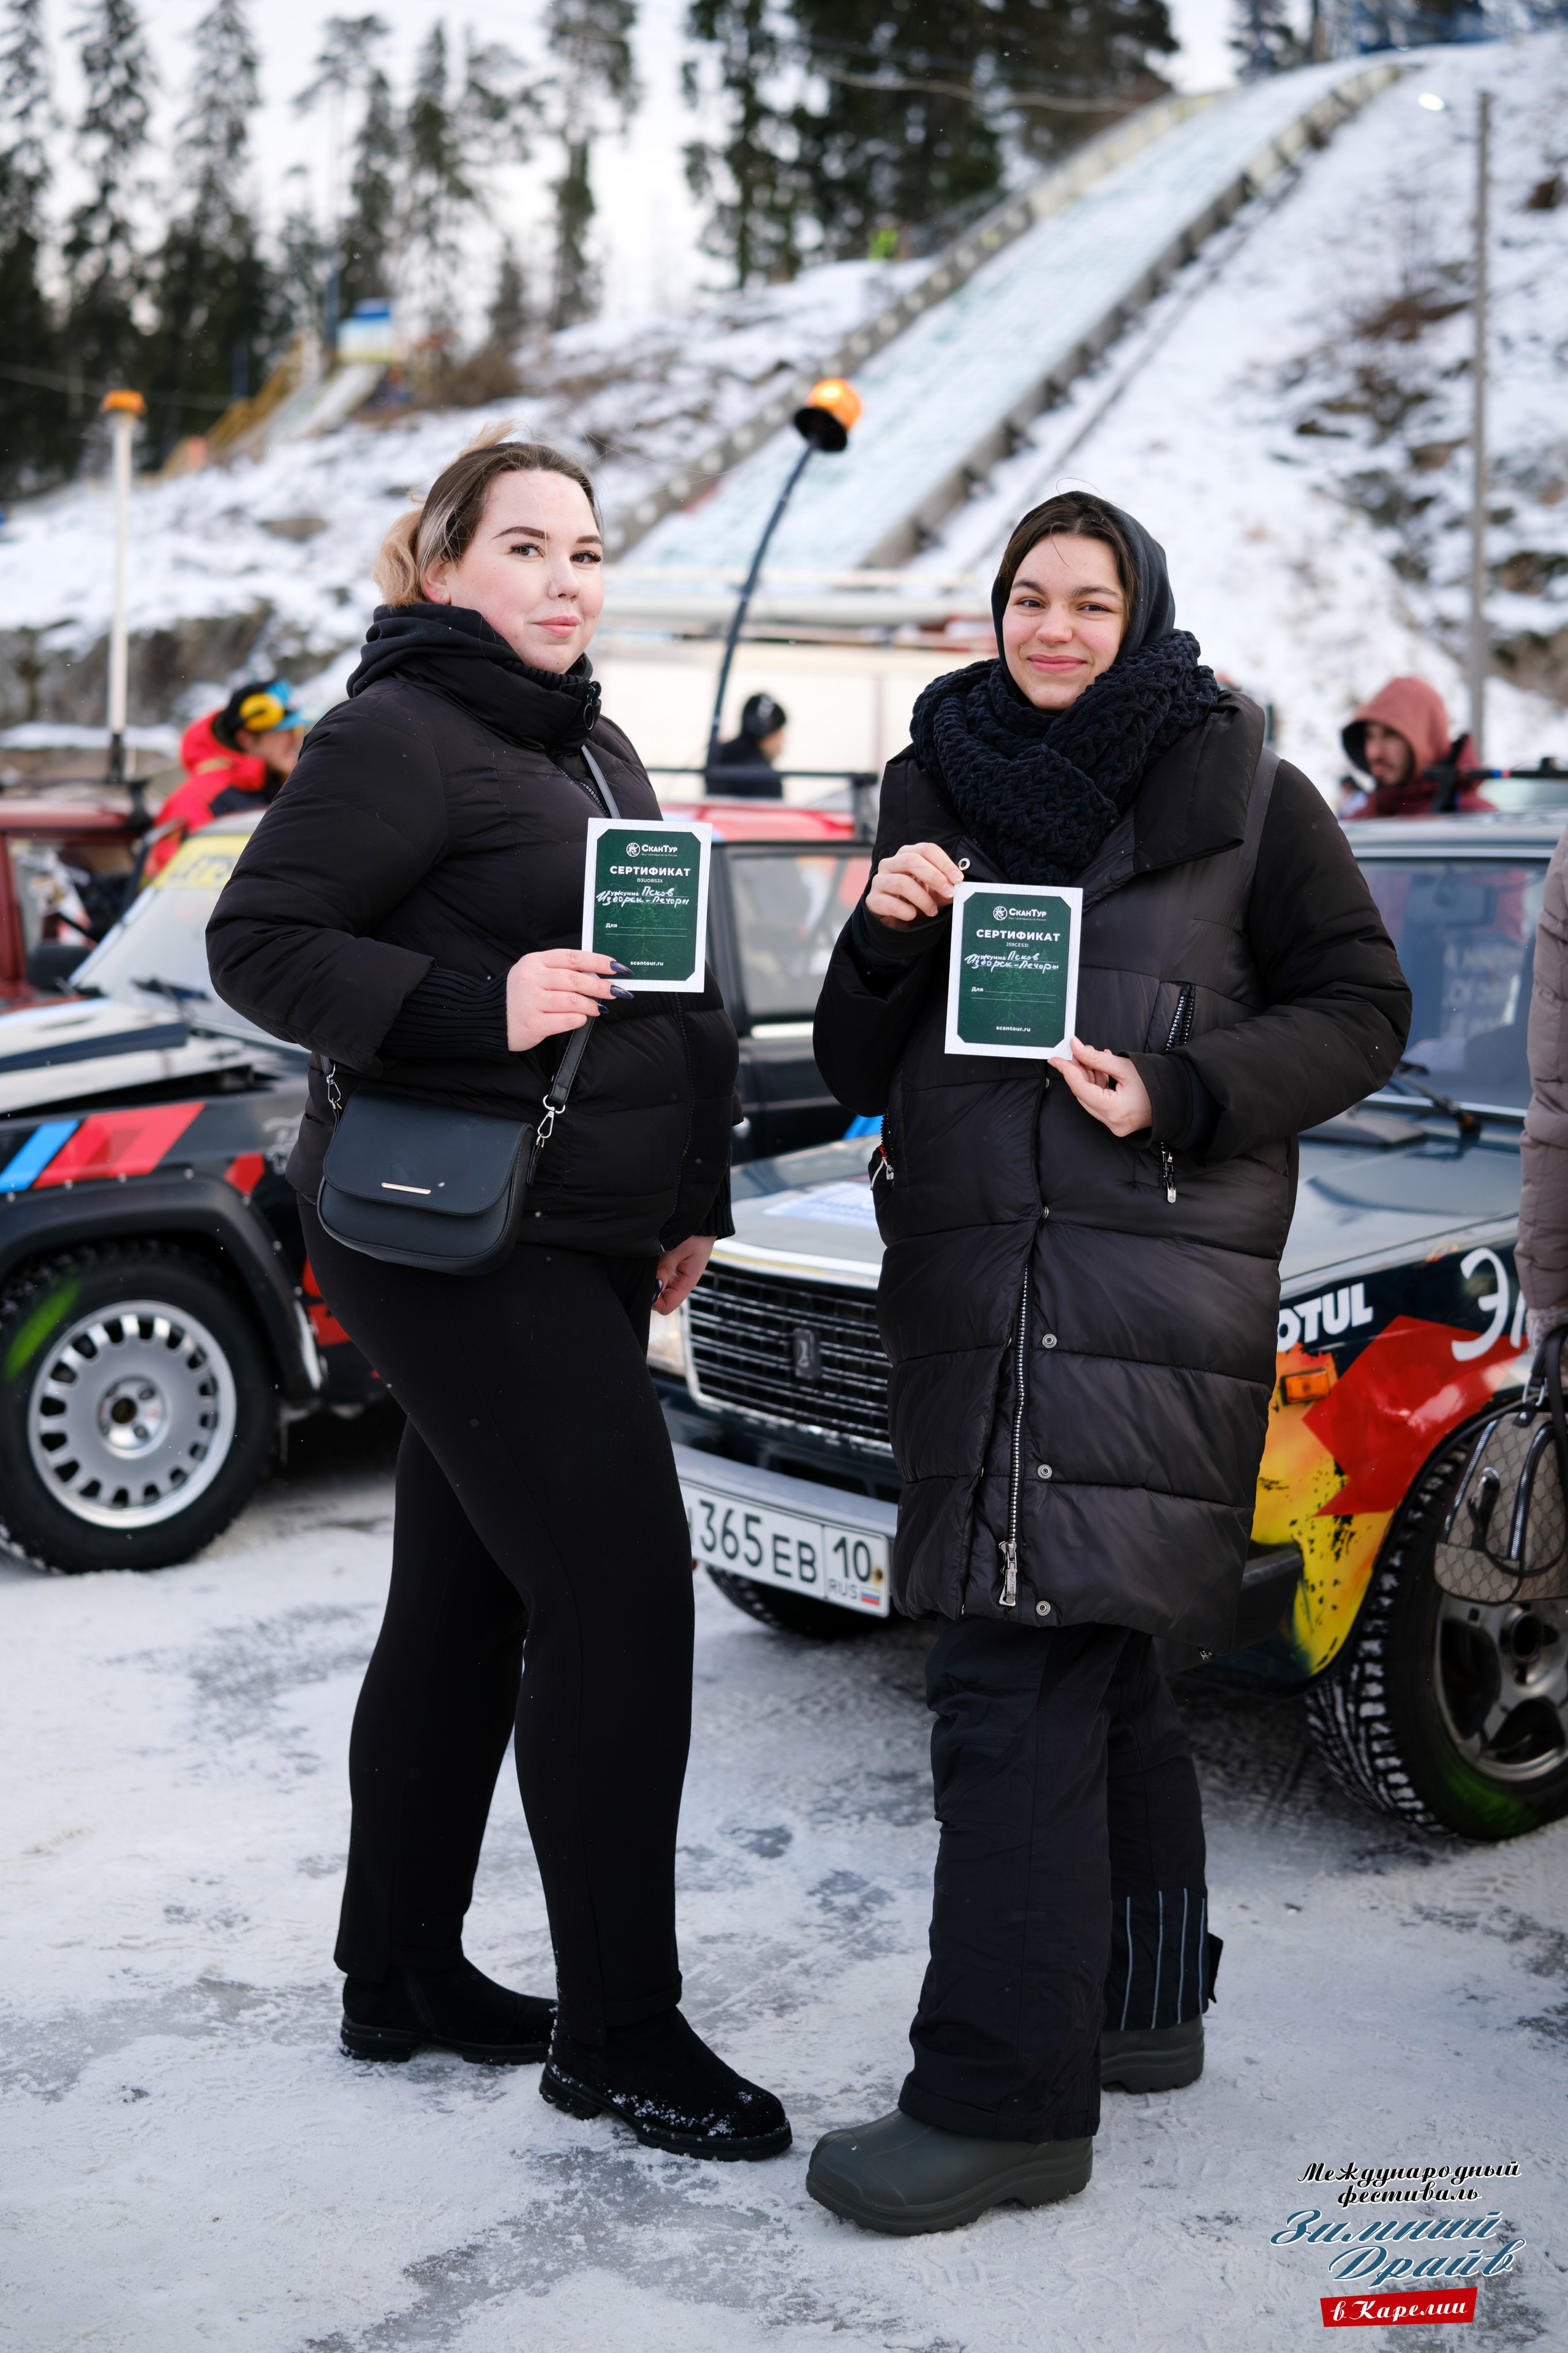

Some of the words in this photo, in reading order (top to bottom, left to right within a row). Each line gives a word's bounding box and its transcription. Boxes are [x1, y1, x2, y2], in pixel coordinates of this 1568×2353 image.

[609, 866, 691, 877] СЕРТИФИКАТ
[976, 929, 1060, 942] СЕРТИФИКАТ
[1278, 1282, 1373, 1352] OTUL
[832, 1536, 872, 1582] 10
[828, 1579, 858, 1600] RUS
